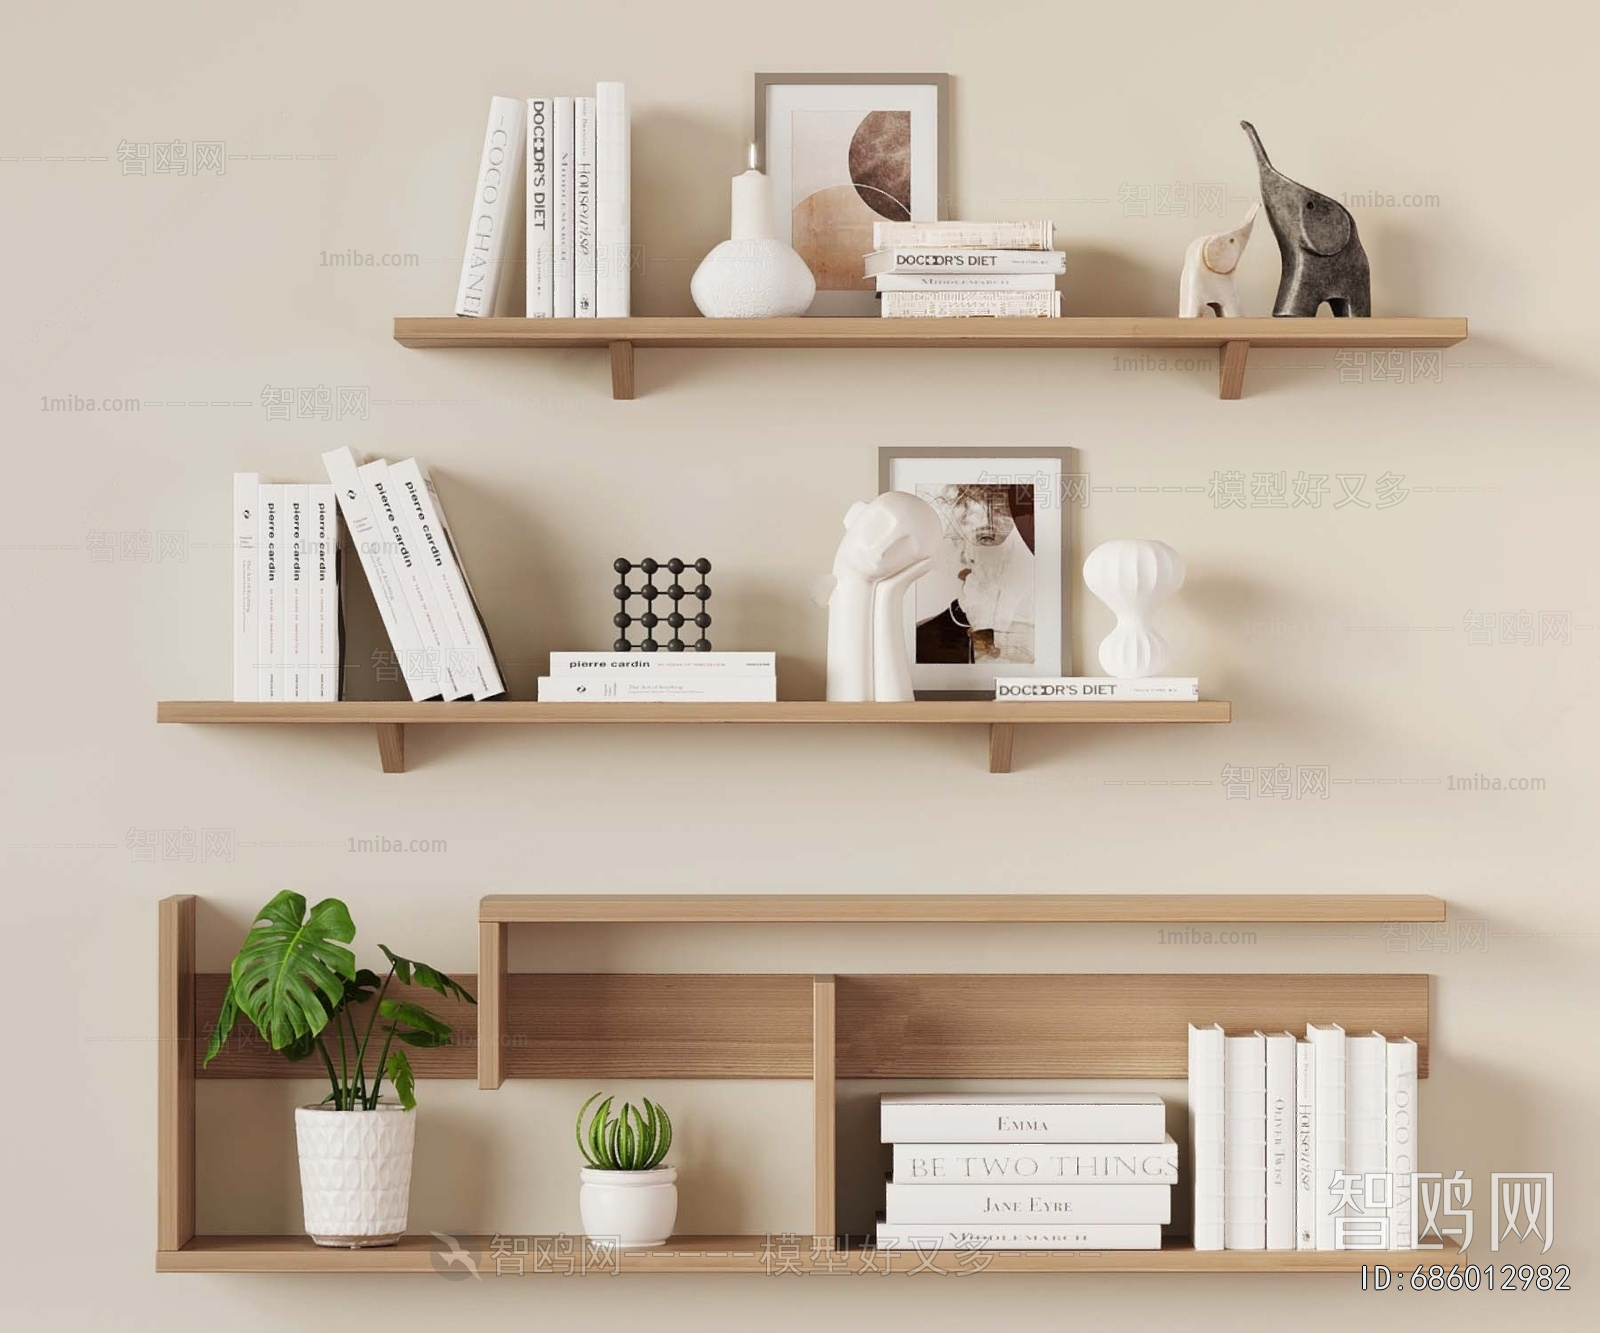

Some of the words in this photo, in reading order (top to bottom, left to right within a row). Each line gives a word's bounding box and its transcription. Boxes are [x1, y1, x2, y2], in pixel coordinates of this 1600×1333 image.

[482, 130, 507, 204] COCO
[534, 193, 546, 230] DIET
[968, 256, 998, 266] DIET
[268, 503, 276, 538] pierre
[293, 503, 301, 538] pierre
[318, 503, 326, 538] pierre
[374, 482, 395, 522] pierre
[392, 526, 413, 568] cardin
[405, 481, 425, 520] pierre
[423, 525, 443, 567] cardin
[569, 660, 607, 669] pierre
[611, 660, 650, 668] cardin
[1082, 685, 1118, 695] DIET
[910, 1157, 946, 1178] BE
[956, 1157, 1039, 1177] TWO
[983, 1197, 1022, 1213] JANE
[1030, 1197, 1073, 1212] EYRE
